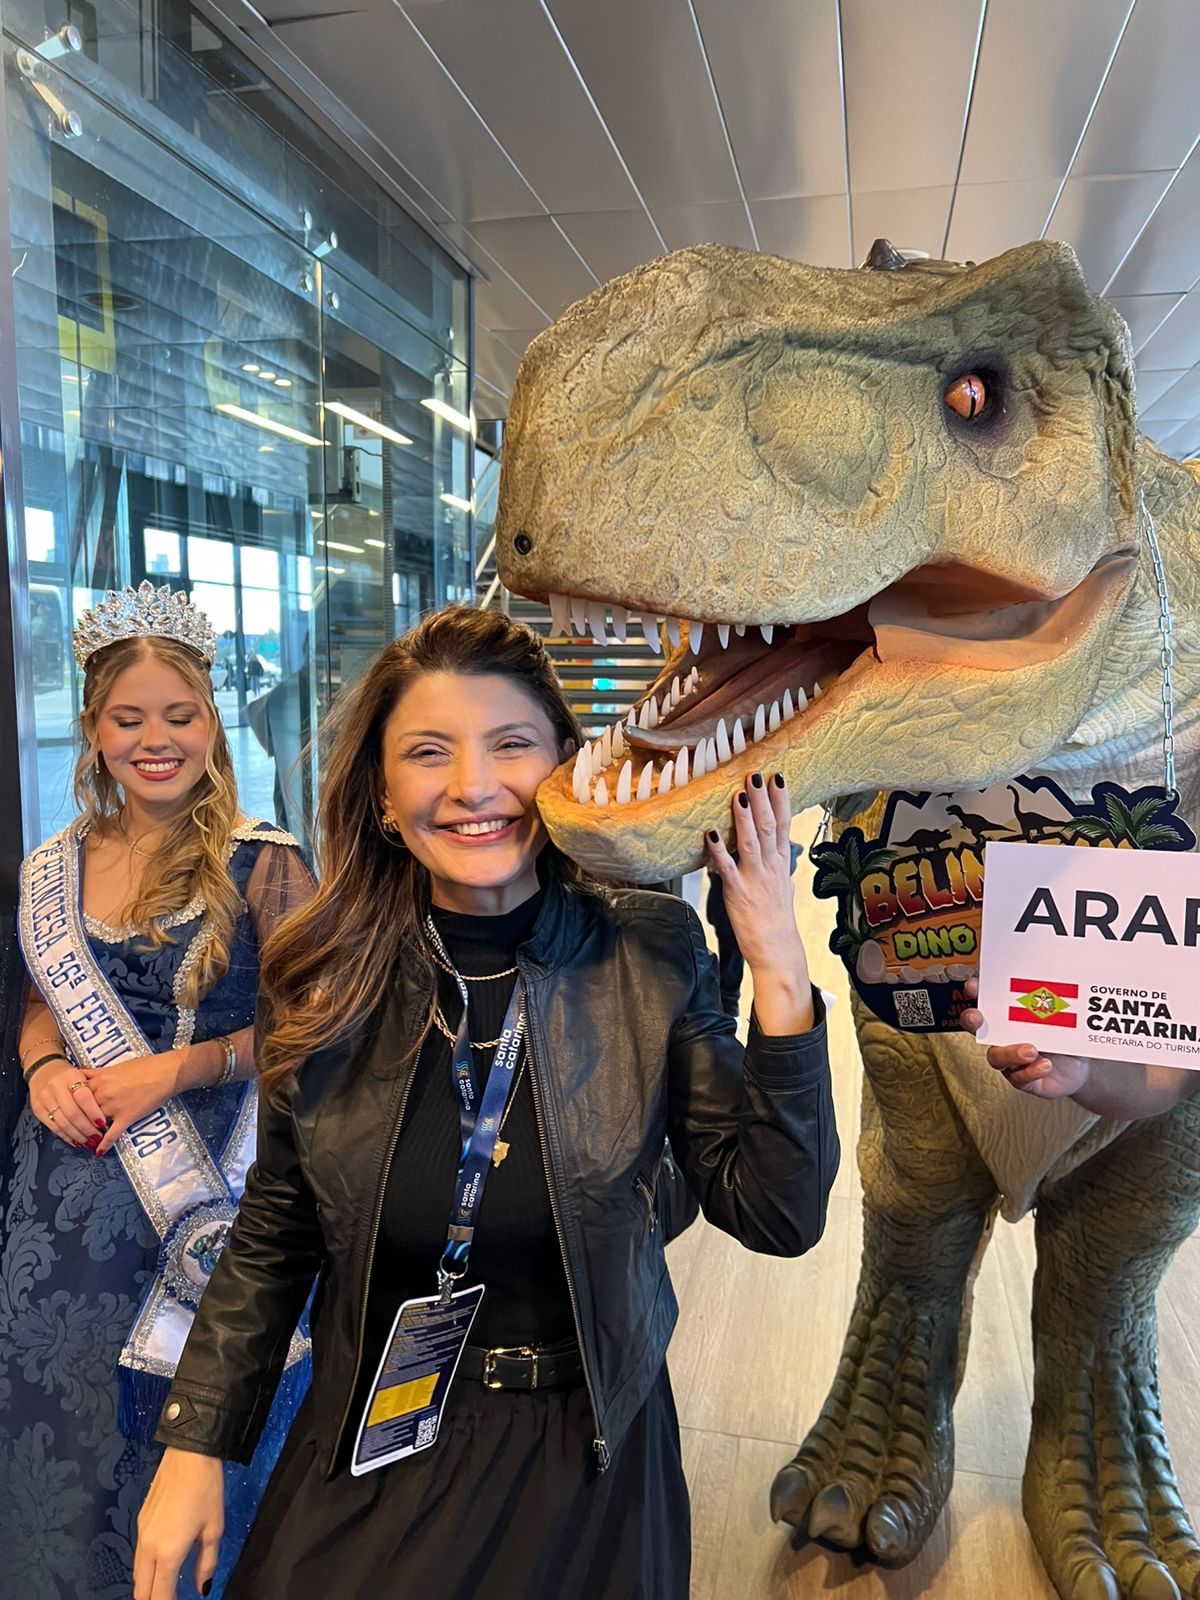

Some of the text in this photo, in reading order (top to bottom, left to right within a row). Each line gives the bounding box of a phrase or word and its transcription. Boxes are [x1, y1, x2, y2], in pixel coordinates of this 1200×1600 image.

[31, 855, 68, 957] PRINCESA
[893, 925, 977, 960] DINO
[46, 951, 88, 990] 36ª
[1090, 985, 1168, 1000] GOVERNO DE
[1087, 996, 1172, 1020] SANTA
[1086, 1014, 1200, 1042] CATARIN
[1088, 1034, 1144, 1048] SECRETARIA
[1146, 1041, 1162, 1050] DO
[495, 1029, 512, 1067] santa
[459, 1079, 471, 1110] catarina
[465, 1078, 474, 1099] santa
[461, 1183, 471, 1206] santa
[468, 1172, 481, 1208] catarina
